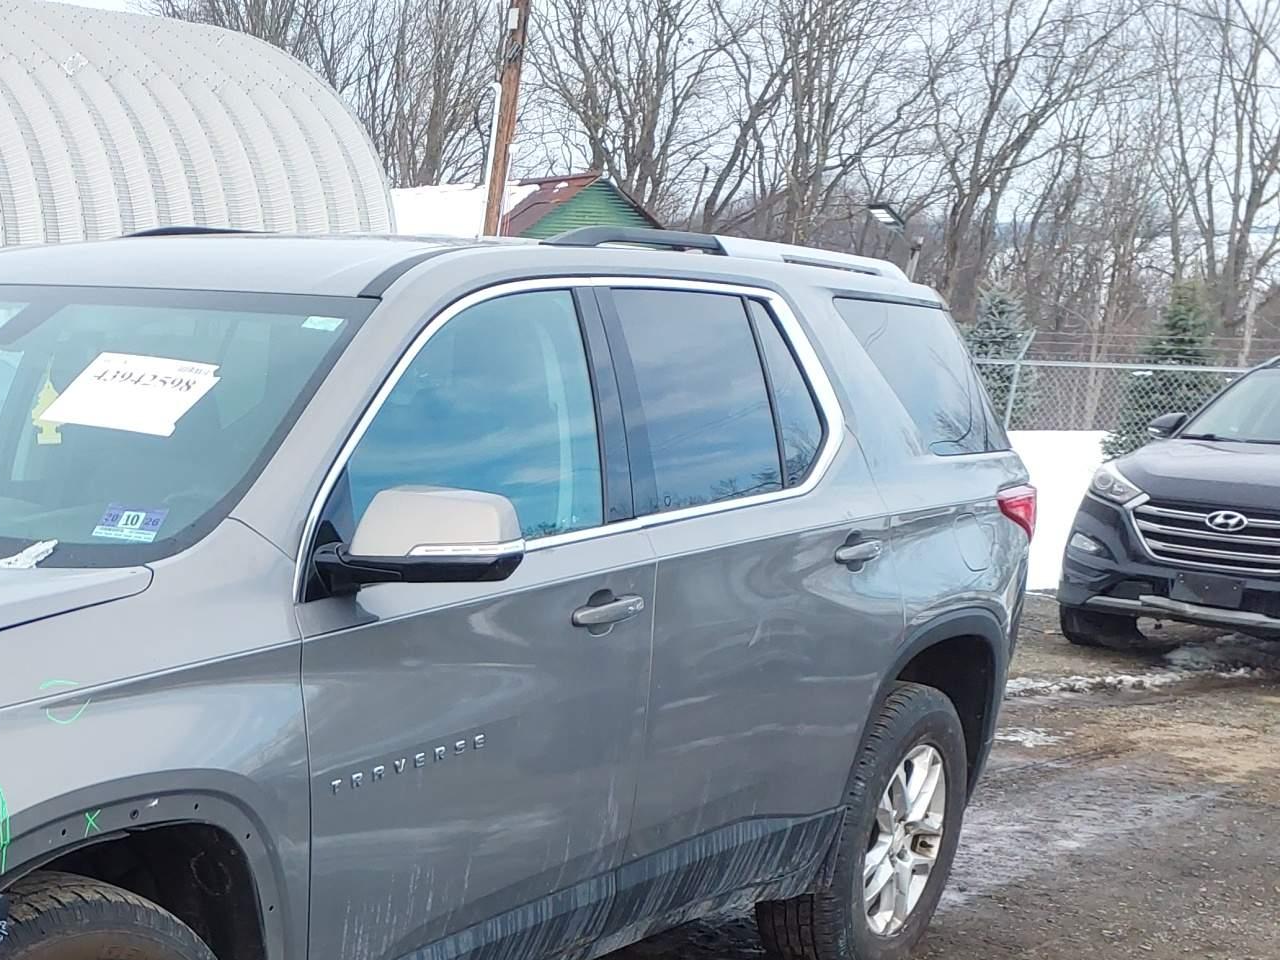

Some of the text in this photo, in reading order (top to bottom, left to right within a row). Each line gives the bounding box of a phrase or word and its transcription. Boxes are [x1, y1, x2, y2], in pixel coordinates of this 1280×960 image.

[93, 368, 197, 393] 43942598
[122, 513, 140, 527] 10
[330, 733, 486, 795] TRAVERSE
